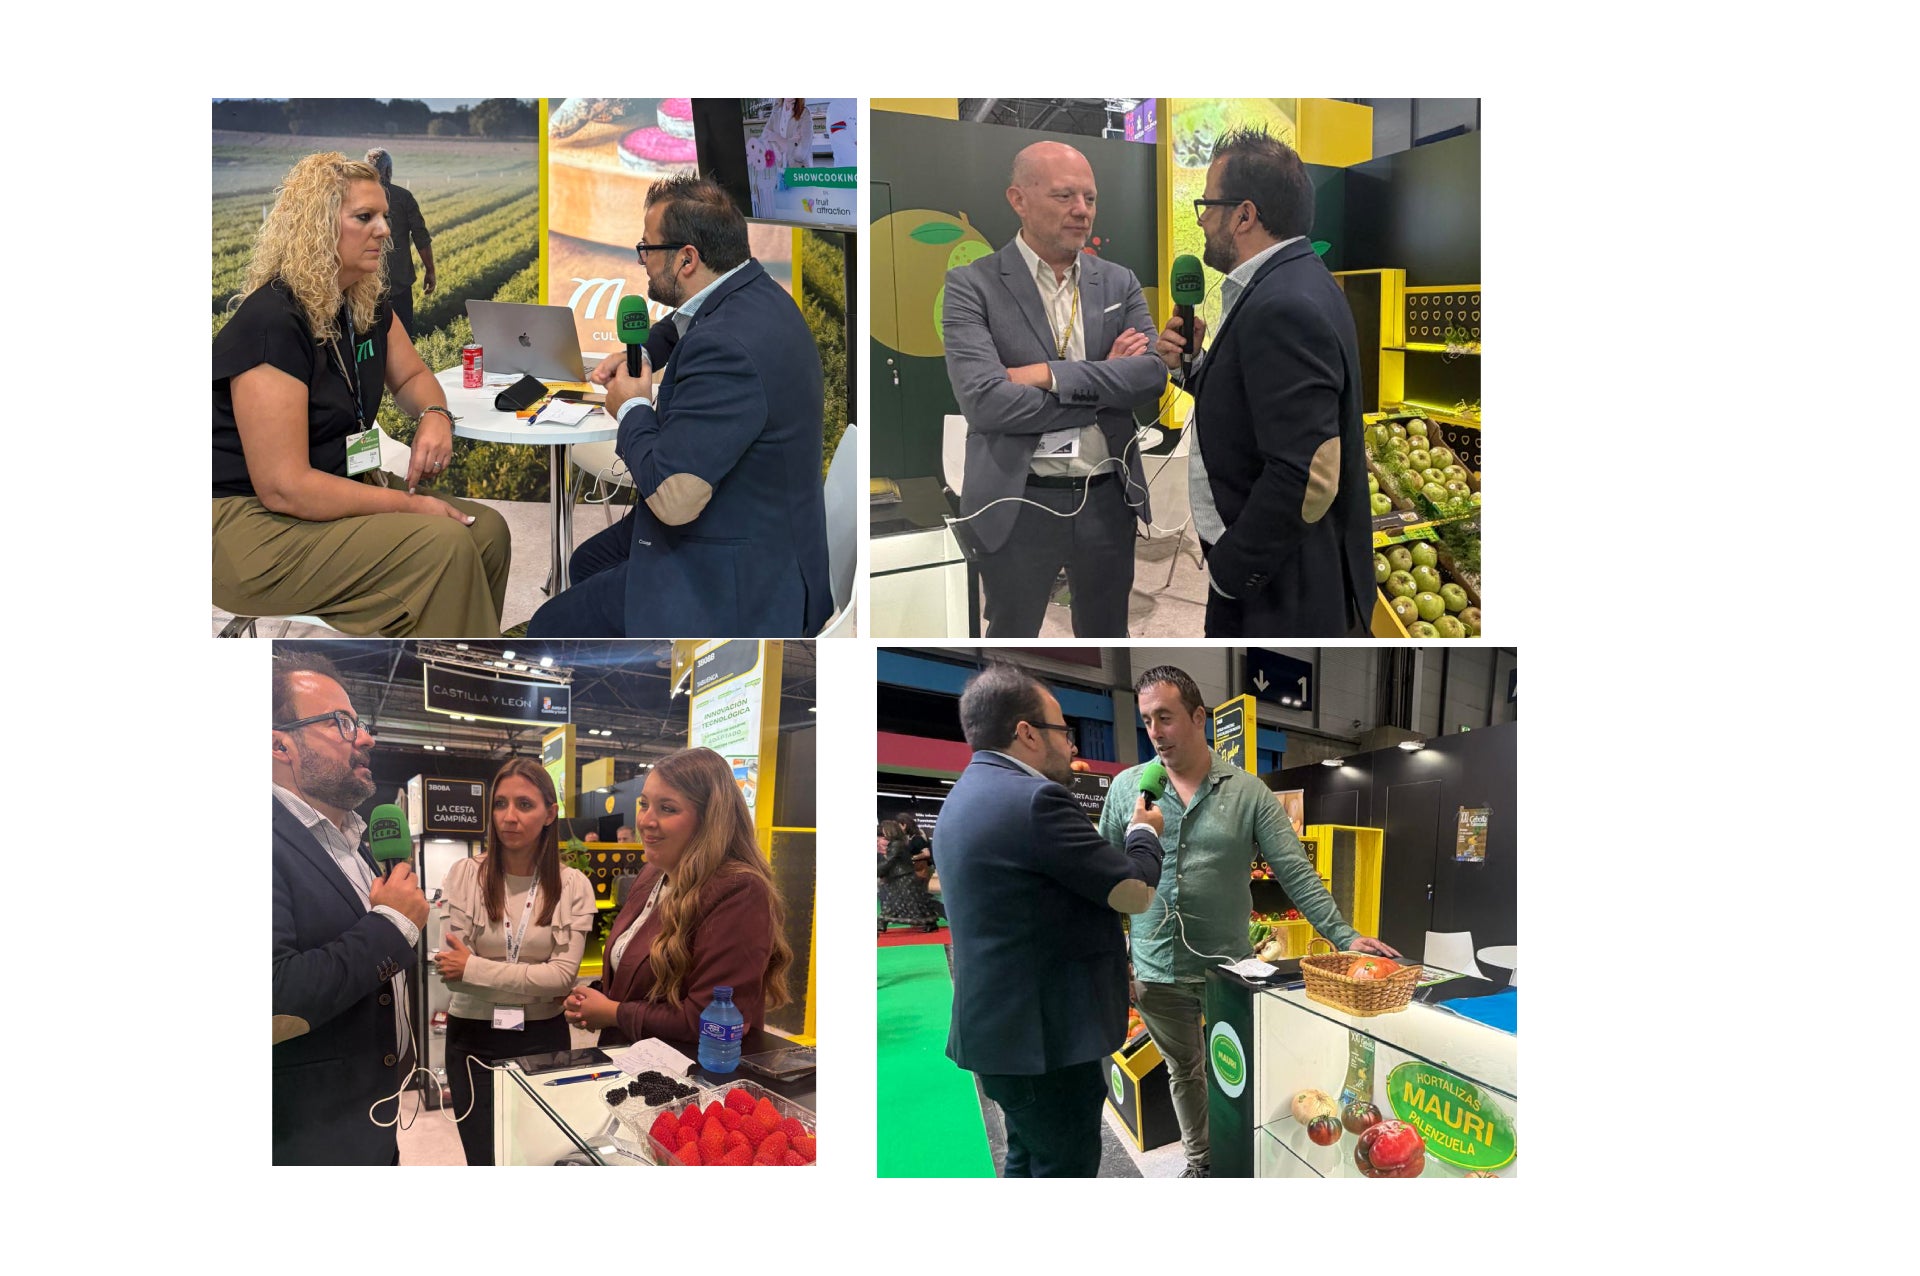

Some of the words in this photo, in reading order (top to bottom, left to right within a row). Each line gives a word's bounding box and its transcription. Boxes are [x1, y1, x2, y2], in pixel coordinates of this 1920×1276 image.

[816, 198, 829, 206] fruit
[816, 206, 851, 215] attraction
[433, 685, 489, 703] CASTILLA
[491, 696, 499, 704] Y
[501, 697, 532, 708] LEÓN
[1297, 676, 1307, 702] 1
[702, 706, 751, 729] TECNOLÓGICA
[704, 698, 748, 720] INNOVACIÓN
[1072, 792, 1107, 802] ORTALIZA
[434, 814, 478, 824] CAMPIÑAS
[436, 804, 447, 812] LA
[449, 805, 475, 813] CESTA
[1416, 1073, 1480, 1111] HORTALIZAS
[1403, 1081, 1494, 1147] MAURI
[1408, 1111, 1475, 1156] PALENZUELA
